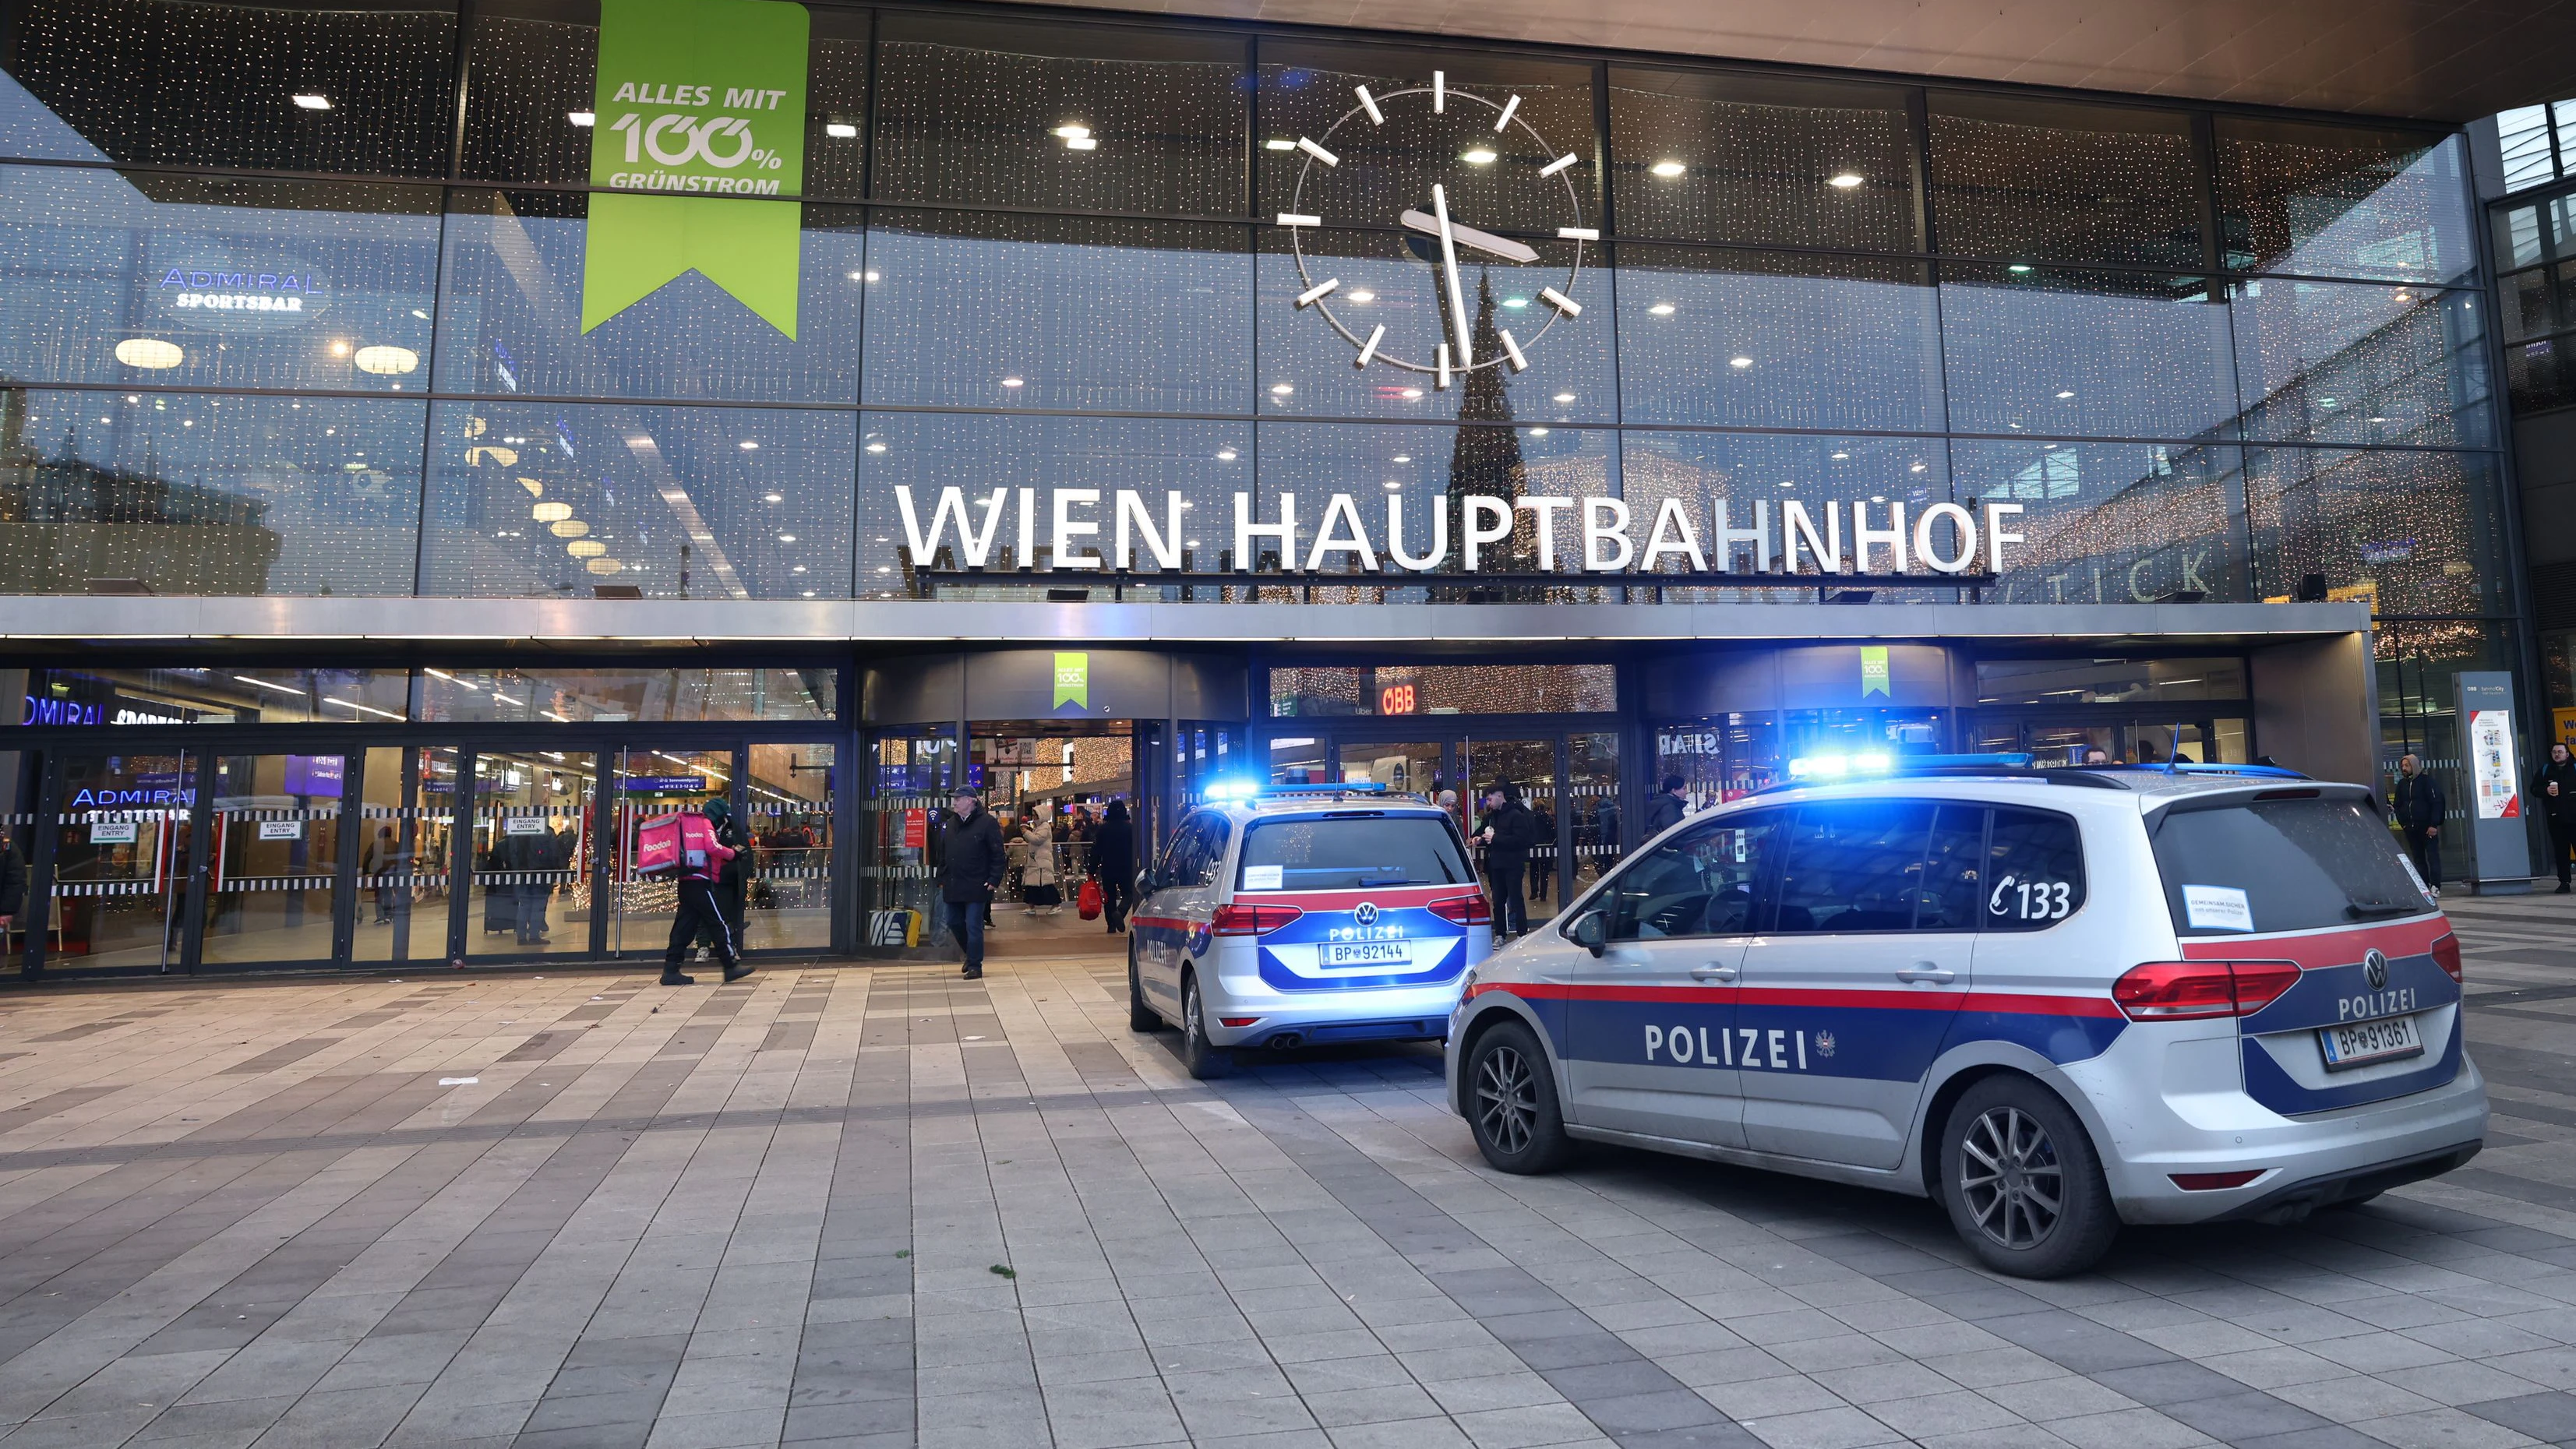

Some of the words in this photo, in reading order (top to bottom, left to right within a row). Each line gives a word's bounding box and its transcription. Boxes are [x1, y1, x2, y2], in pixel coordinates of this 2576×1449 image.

[612, 82, 711, 107] ALLES
[723, 87, 786, 111] MIT
[609, 113, 782, 170] 100%
[609, 170, 780, 196] GRÜNSTROM
[160, 268, 324, 294] ADMIRAL
[176, 293, 303, 312] SPORTSBAR
[895, 485, 1181, 569] WIEN
[1235, 492, 2024, 573] HAUPTBAHNHOF
[23, 696, 104, 725] DMIRA
[1382, 685, 1415, 715] ÖBB
[2017, 881, 2070, 920] 133
[1329, 925, 1403, 941] POLIZEI
[1147, 939, 1166, 965] POLIZEI
[1336, 947, 1351, 961] BP
[1363, 944, 1403, 959] 92144
[2338, 988, 2415, 1021] POLIZEI
[1645, 1024, 1808, 1070] POLIZEI
[2339, 1030, 2357, 1055] BP
[2368, 1021, 2412, 1050] 91361
